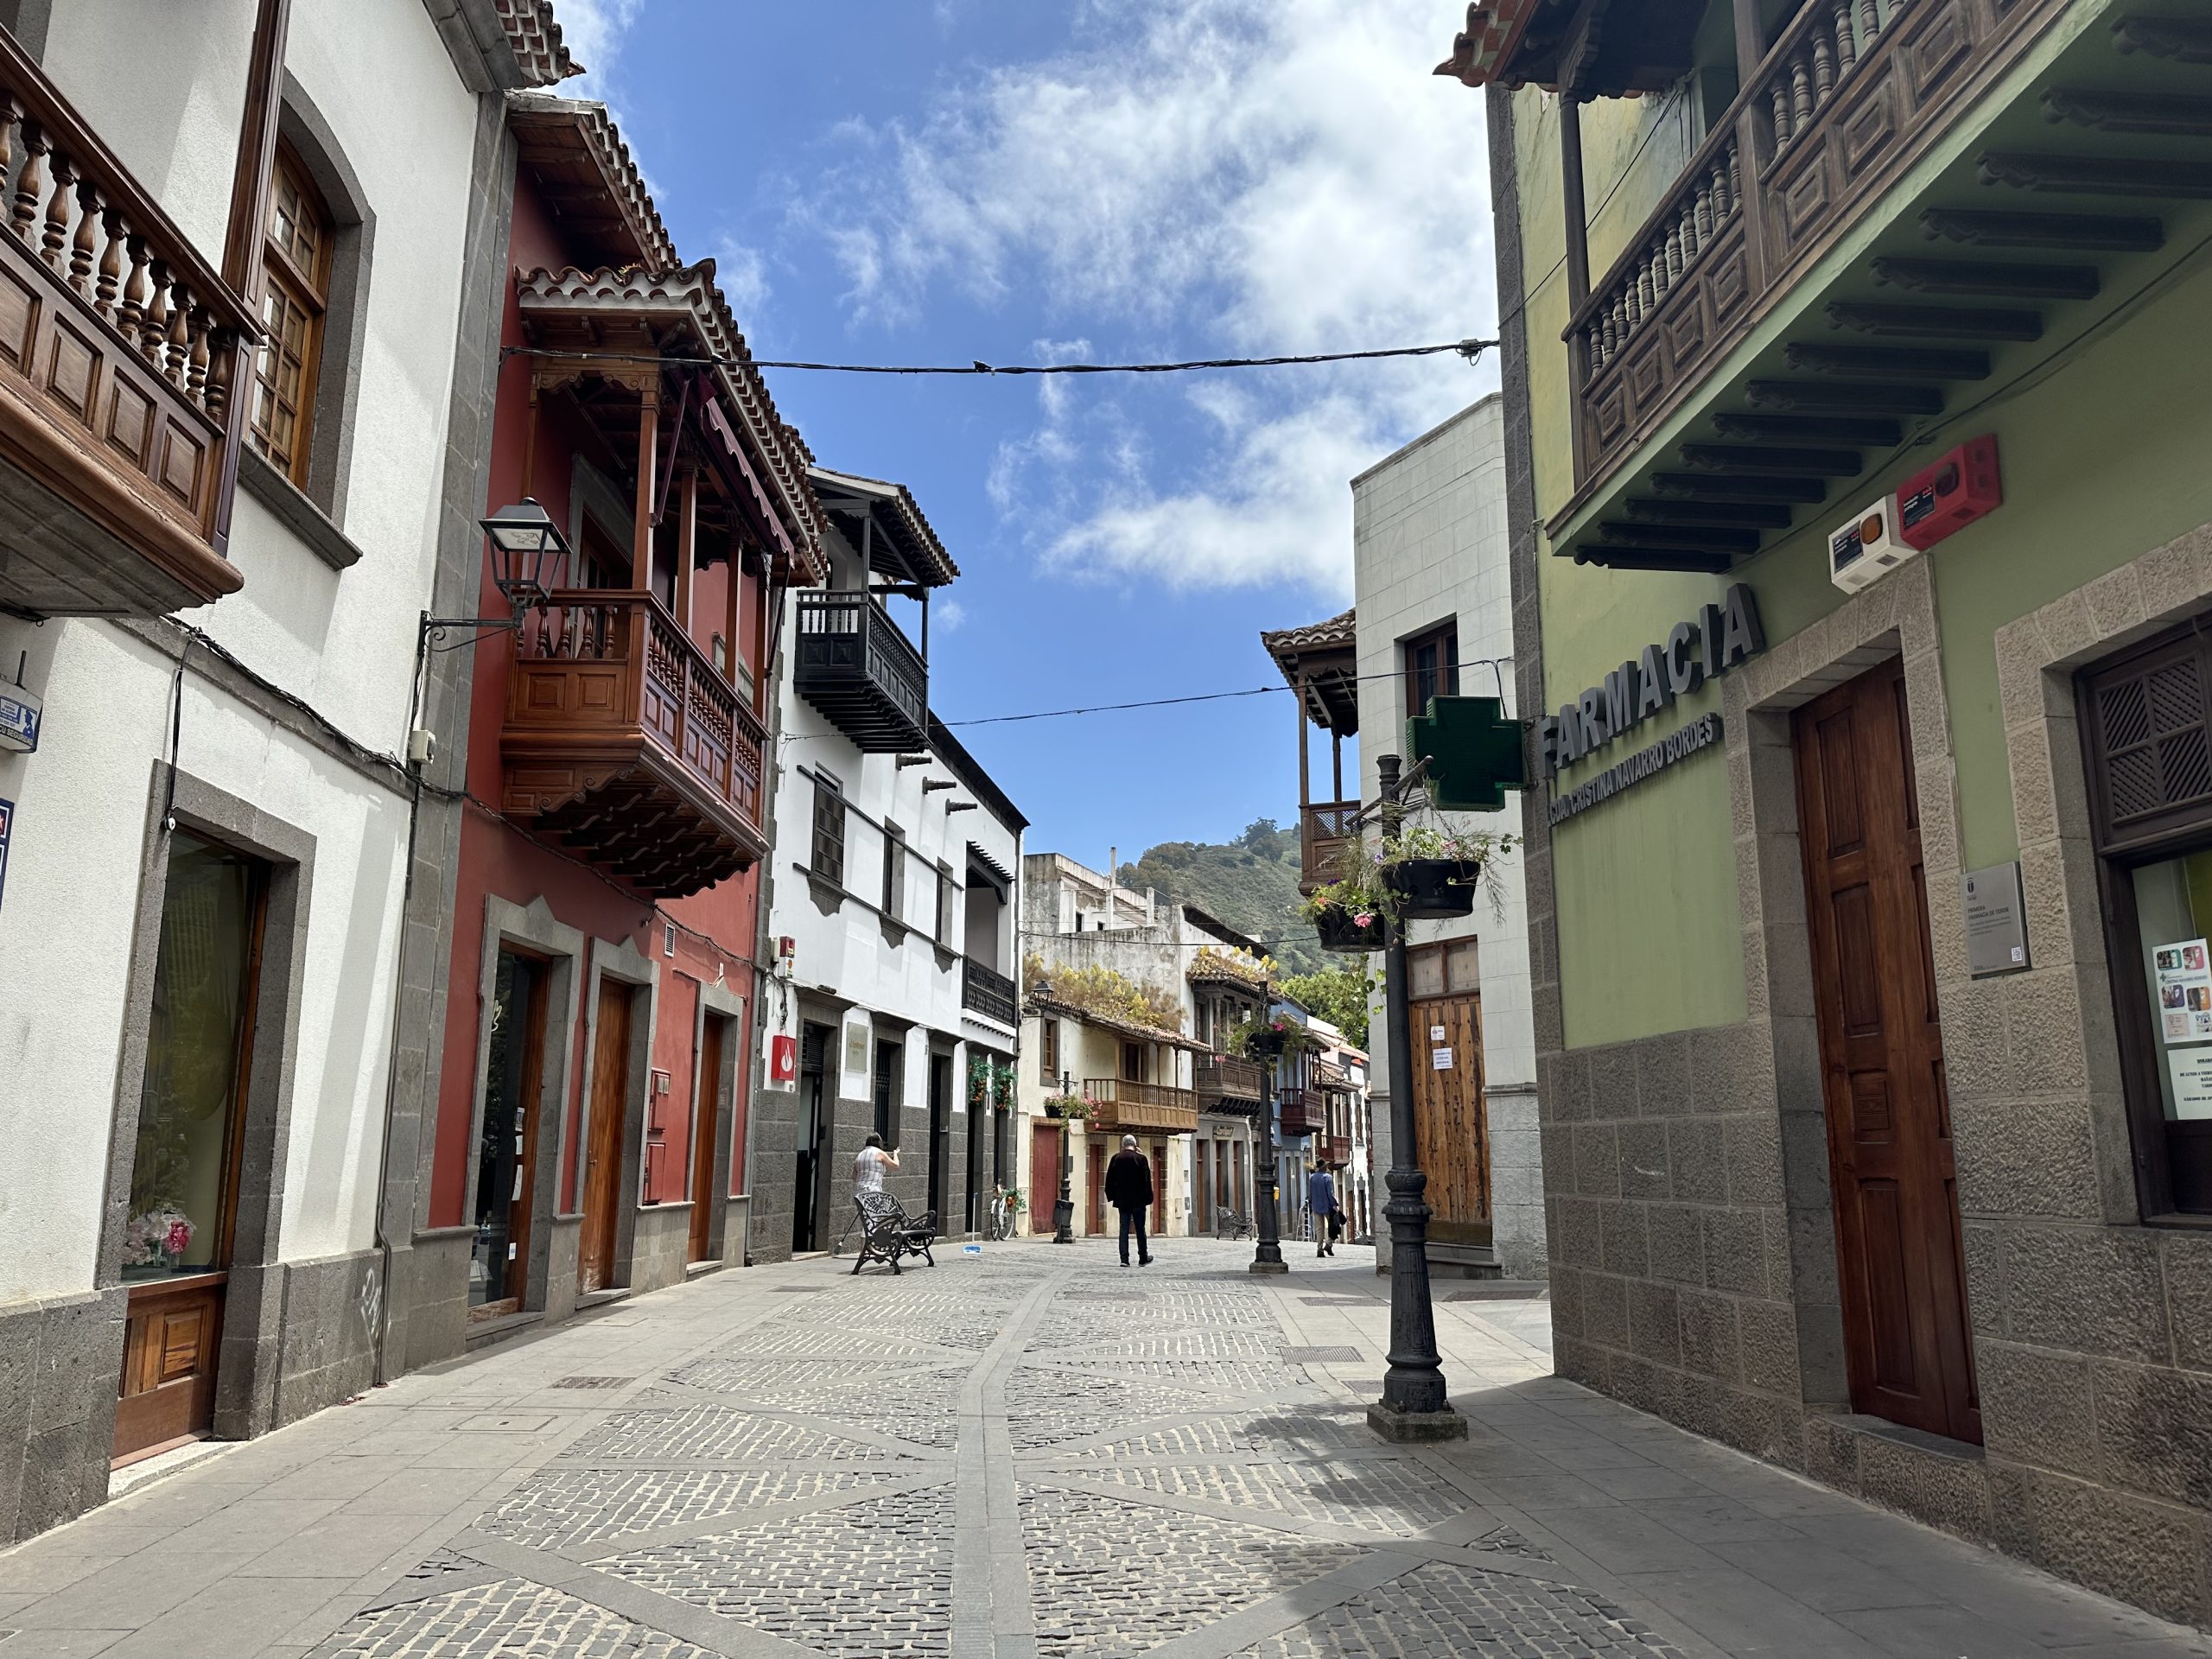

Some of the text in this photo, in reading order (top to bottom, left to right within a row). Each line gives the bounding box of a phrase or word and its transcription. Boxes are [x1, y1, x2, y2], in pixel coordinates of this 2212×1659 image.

[1539, 582, 1764, 779] FARMACIA
[7, 728, 33, 745] SEGURIDAD
[1571, 768, 1615, 814] CRISTINA
[1615, 740, 1666, 791] NAVARRO
[1666, 712, 1720, 765] BORDES
